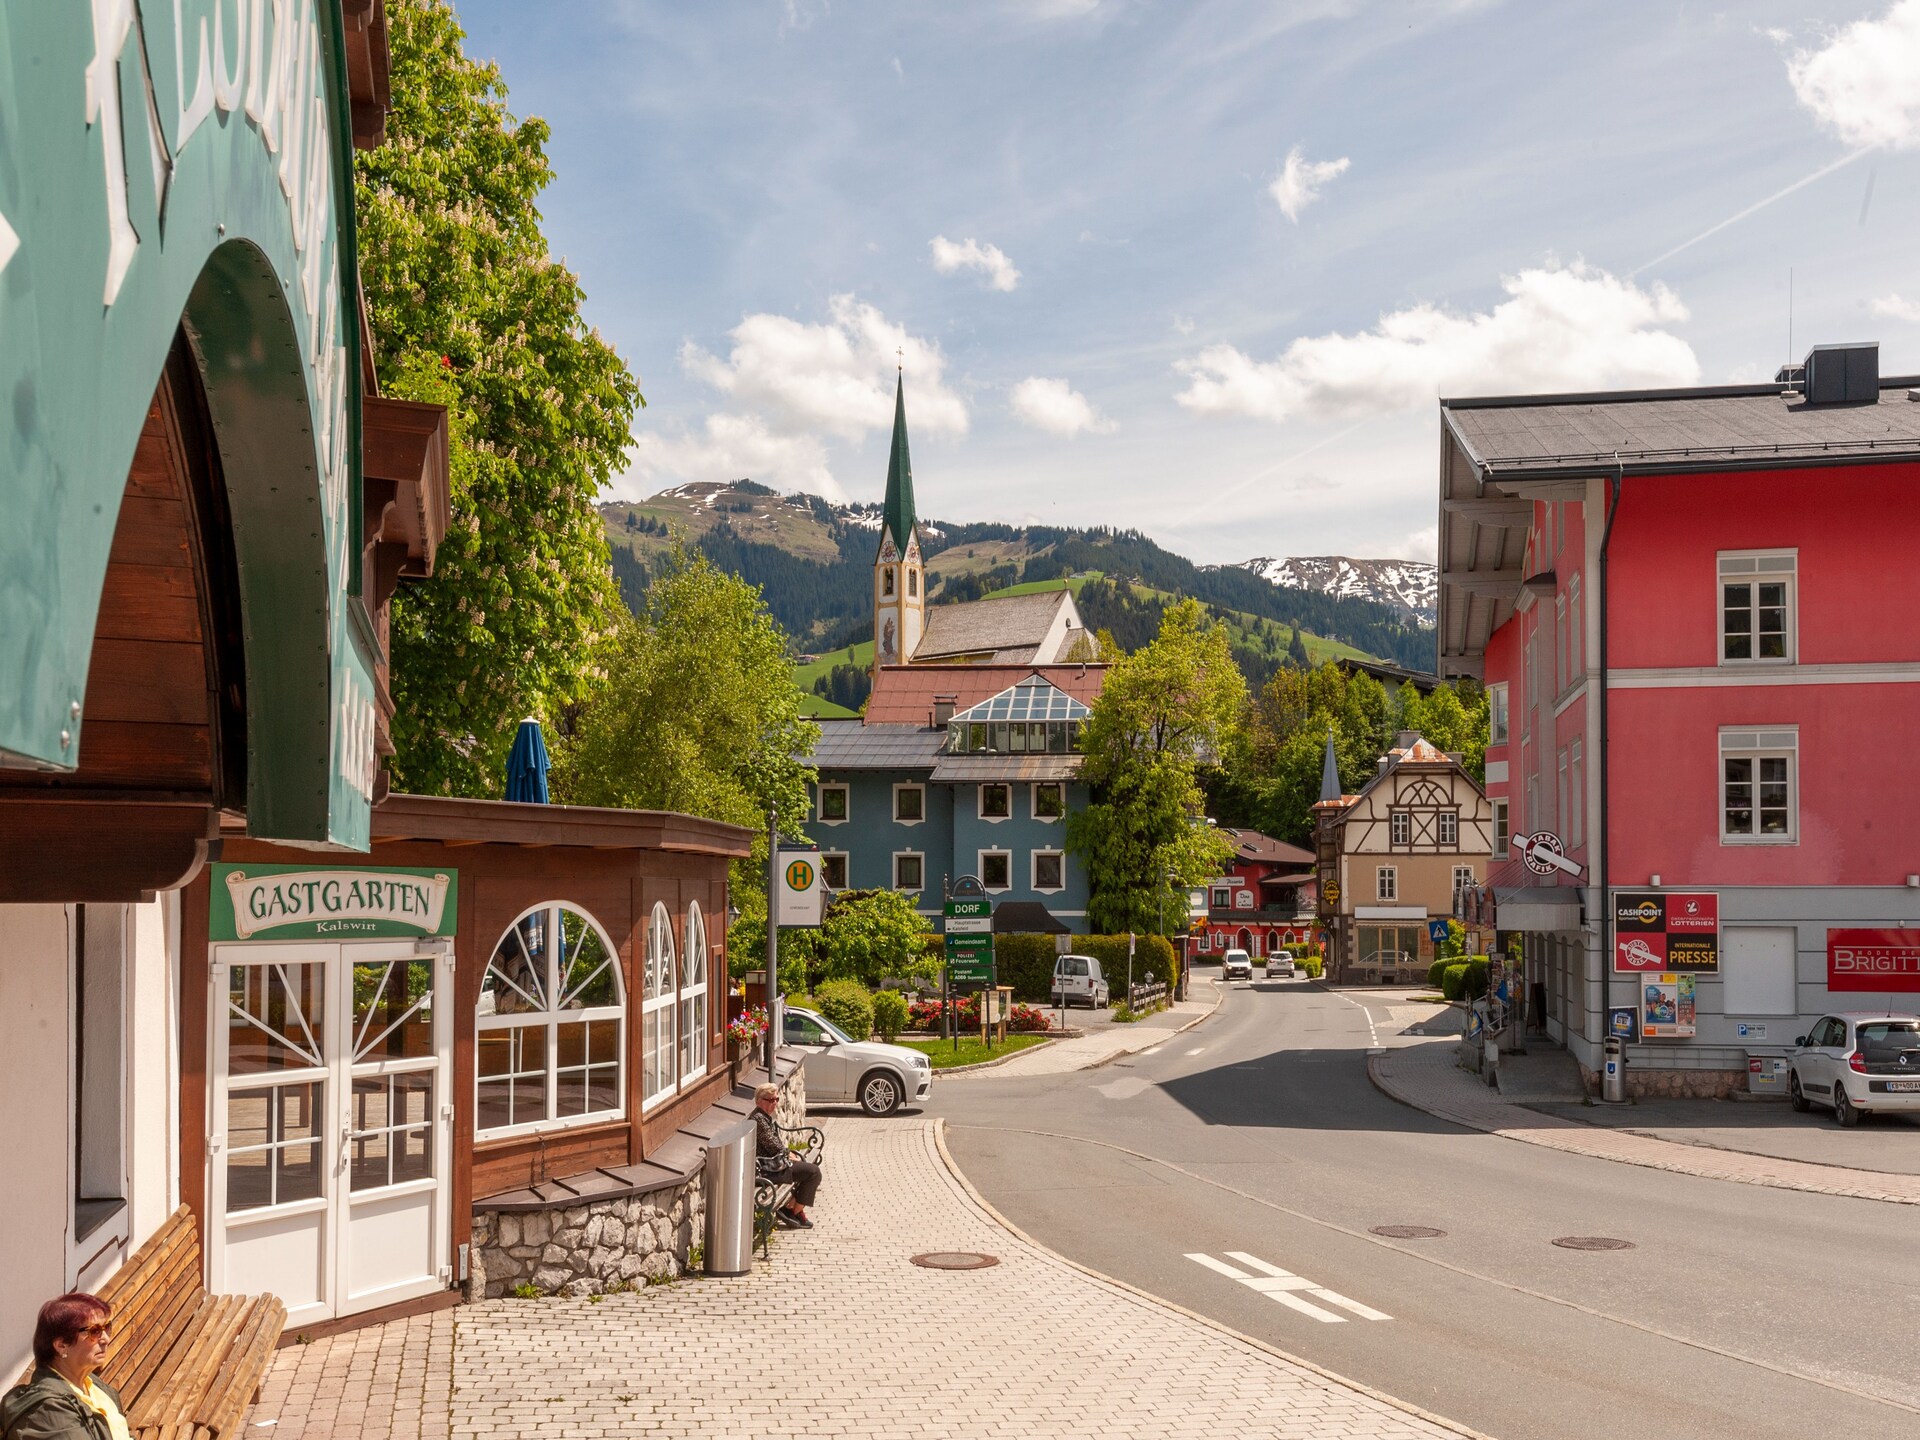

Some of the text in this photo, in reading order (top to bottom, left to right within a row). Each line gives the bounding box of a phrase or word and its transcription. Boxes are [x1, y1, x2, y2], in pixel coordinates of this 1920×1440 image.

[1532, 835, 1561, 852] TABAK
[1526, 849, 1552, 872] TRAFIK
[793, 866, 807, 885] H
[249, 879, 431, 919] GASTGARTEN
[954, 904, 980, 914] DORF
[1618, 909, 1662, 917] CASHPOINT
[316, 921, 377, 933] Kalswirt
[1669, 951, 1716, 964] PRESSE
[1739, 1025, 1746, 1035] P
